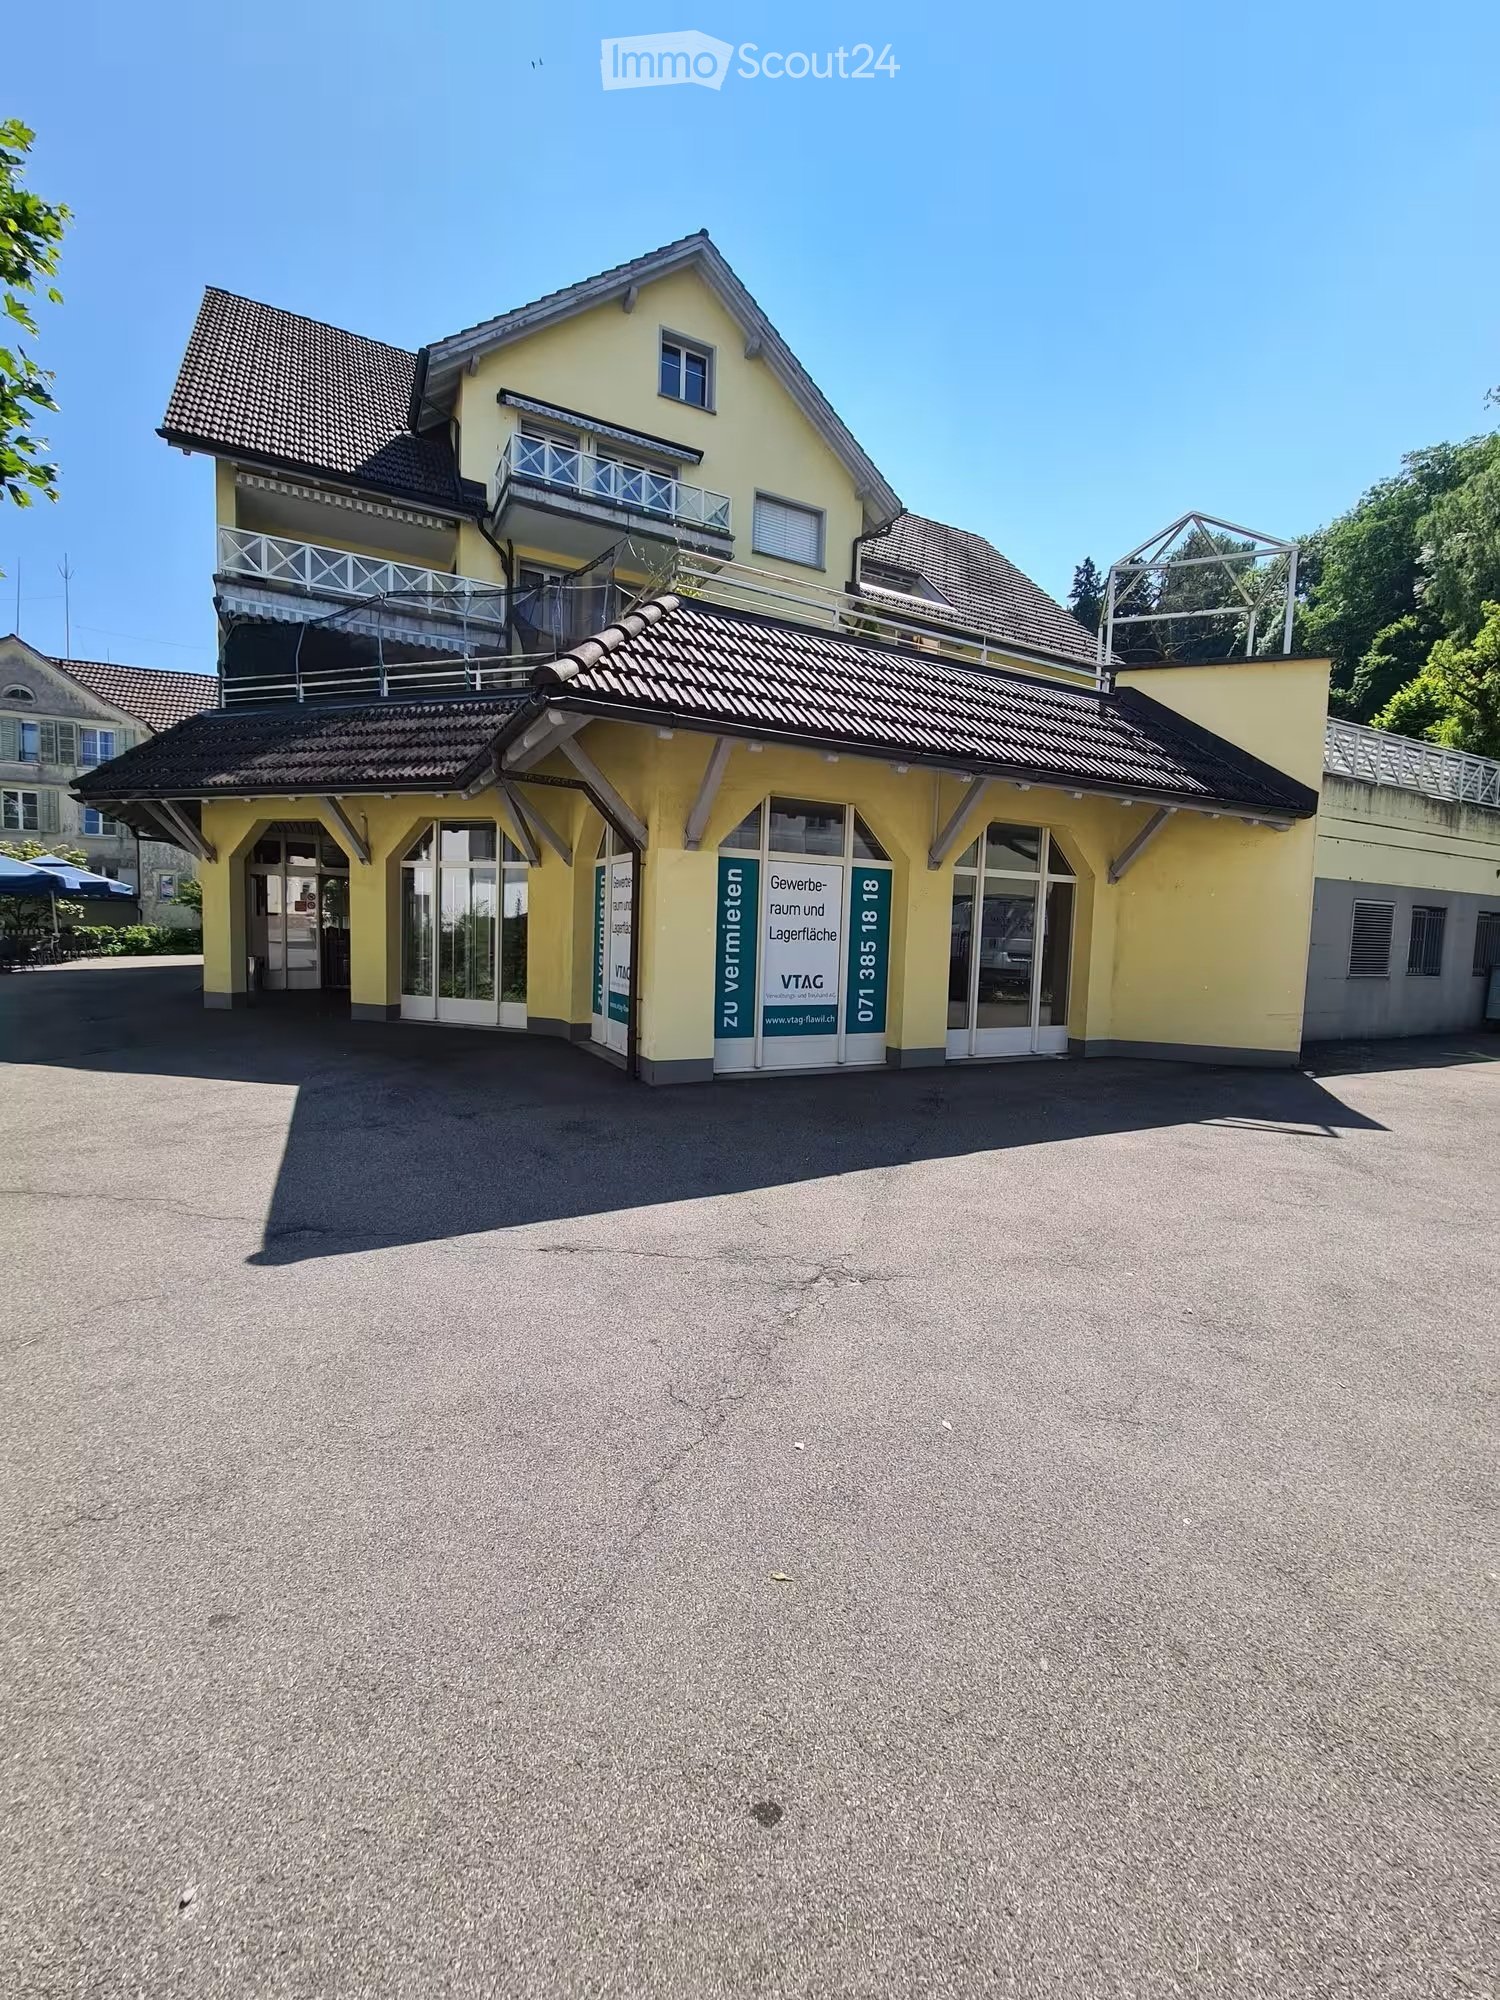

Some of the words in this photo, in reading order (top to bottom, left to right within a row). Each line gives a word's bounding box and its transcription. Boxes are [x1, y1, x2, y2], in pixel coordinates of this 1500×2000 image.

[770, 875, 828, 892] Gewerbe-
[862, 879, 879, 902] 18
[769, 903, 801, 916] raum
[803, 903, 825, 917] und
[861, 910, 878, 933] 18
[722, 868, 743, 993] vermieten
[769, 926, 837, 943] Lagerfläche
[859, 940, 877, 980] 385
[781, 974, 824, 989] VTAG
[723, 1001, 739, 1028] zu
[857, 988, 875, 1023] 071
[765, 1014, 835, 1026] www.vtag-flawil.ch
